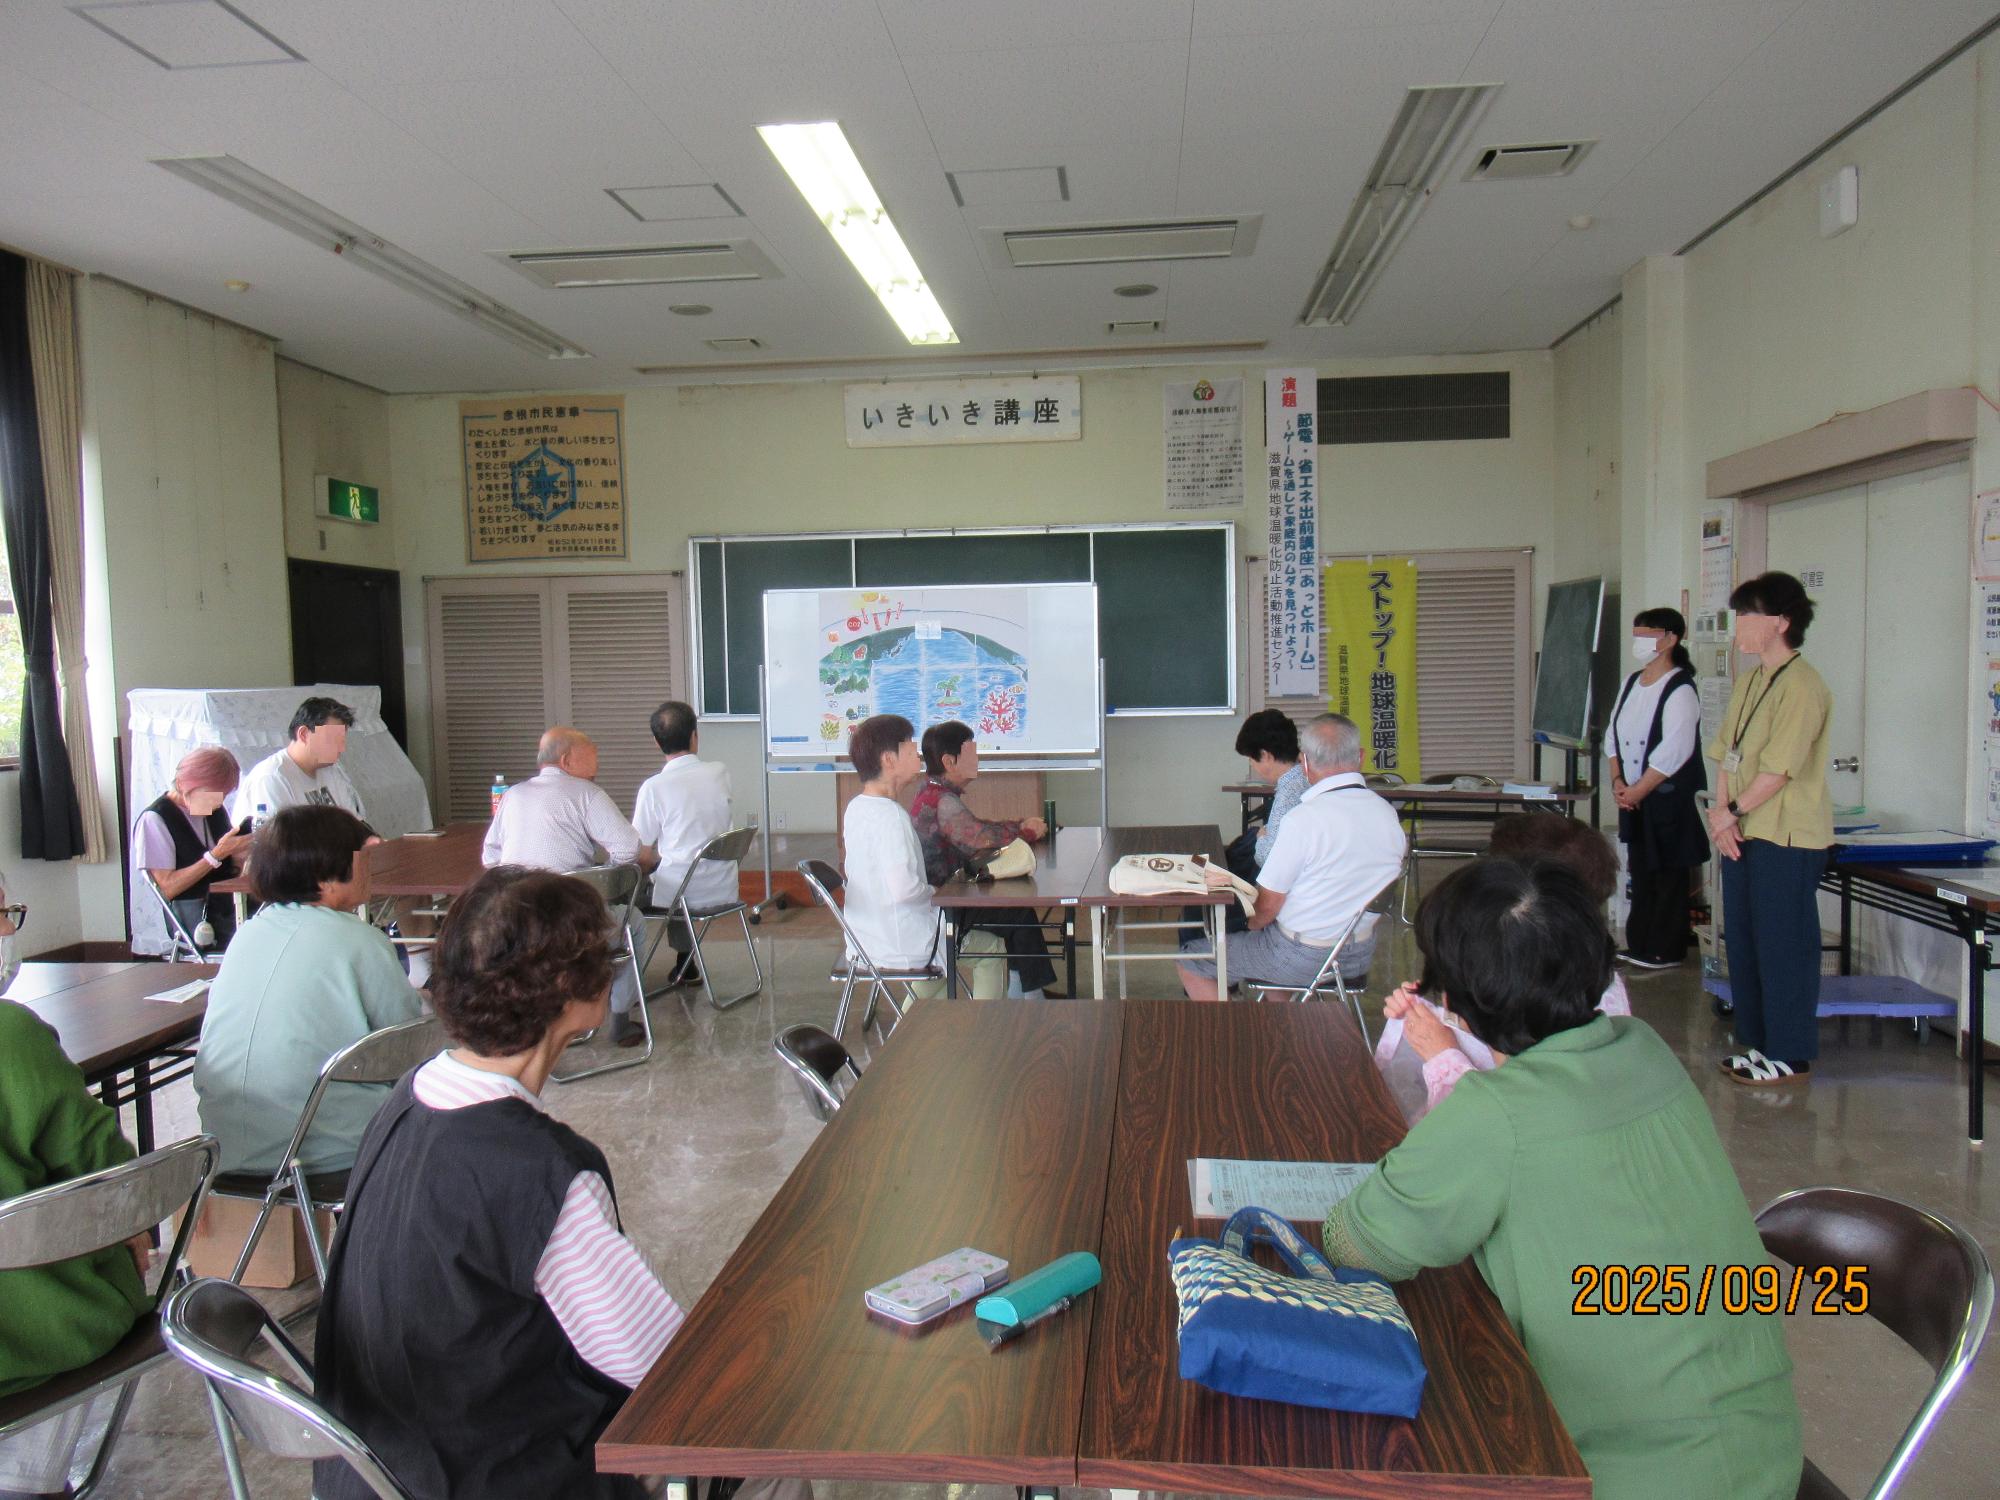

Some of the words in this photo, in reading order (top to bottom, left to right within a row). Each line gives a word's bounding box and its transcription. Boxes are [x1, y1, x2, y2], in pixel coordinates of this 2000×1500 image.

[1281, 377, 1298, 408] 演題
[863, 398, 1060, 430] いきいき講座
[1268, 452, 1283, 686] 滋賀県地球温暖化防止活動推進センター
